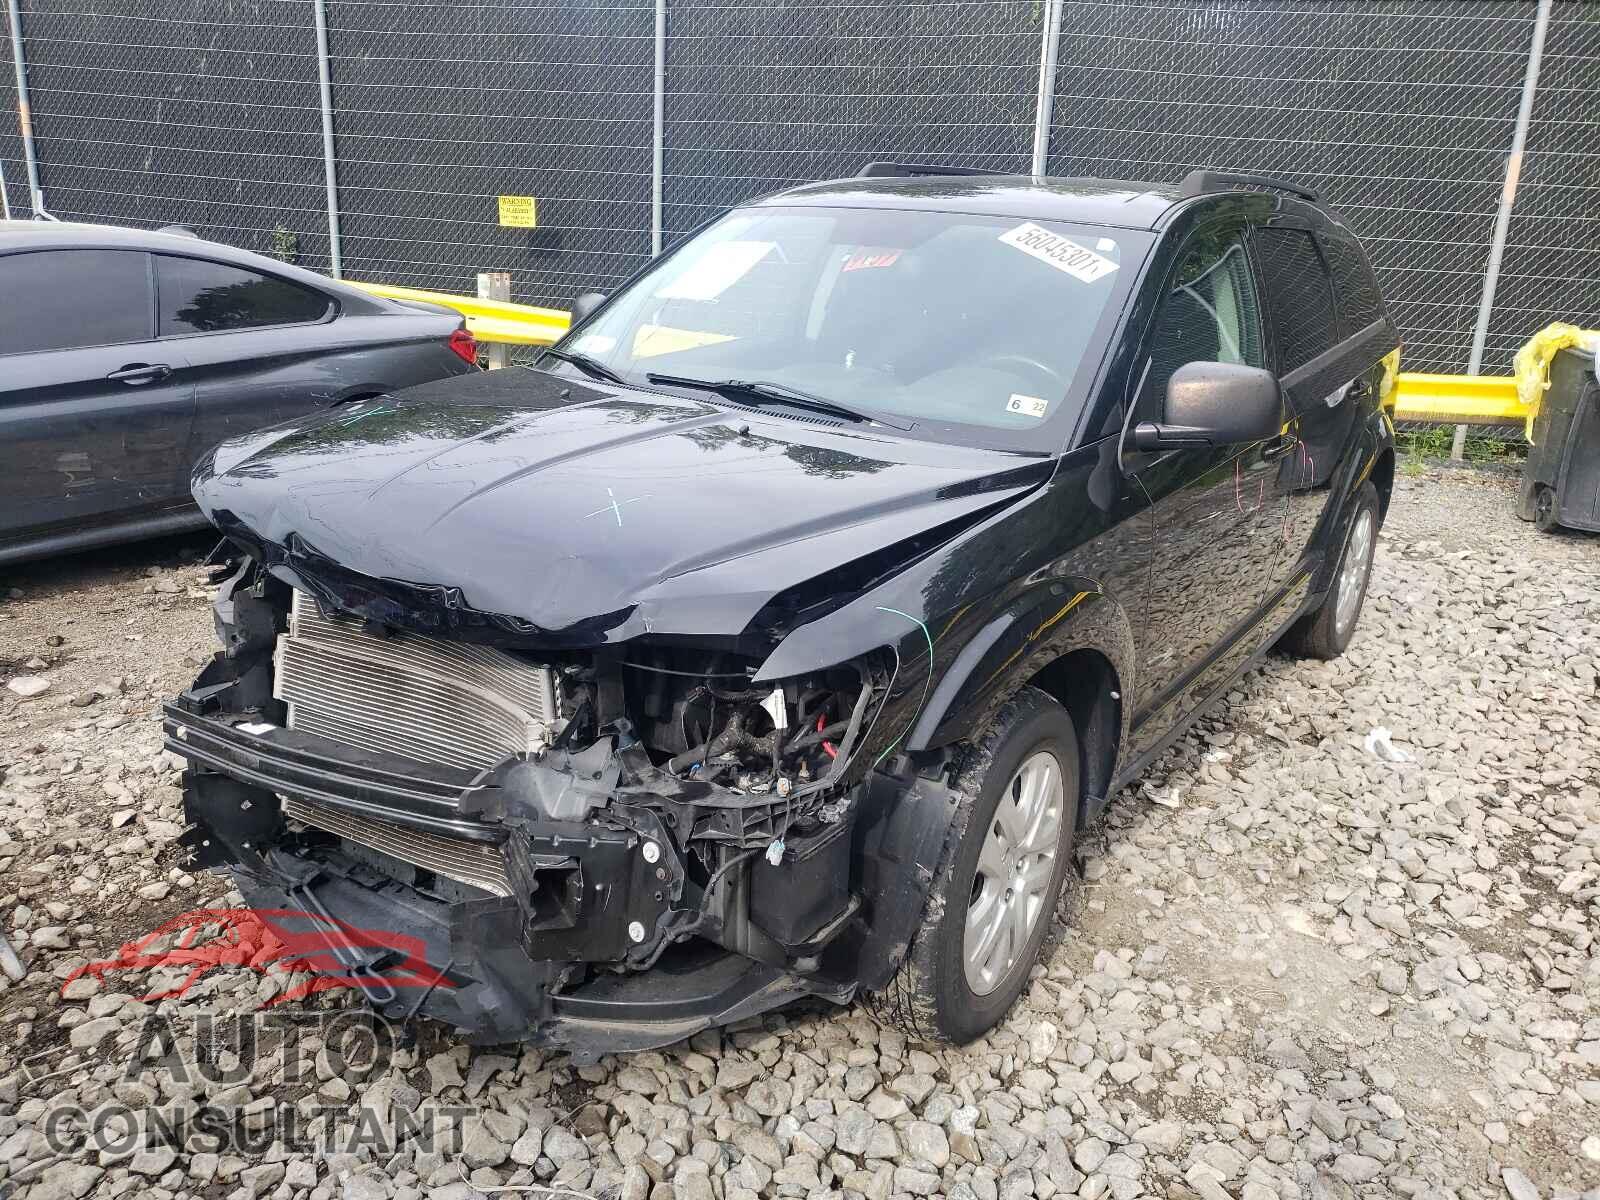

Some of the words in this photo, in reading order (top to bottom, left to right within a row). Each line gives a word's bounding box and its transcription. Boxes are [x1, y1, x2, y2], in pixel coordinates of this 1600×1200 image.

[501, 197, 532, 206] WARNING
[1011, 399, 1022, 410] 6
[1032, 402, 1046, 412] 22
